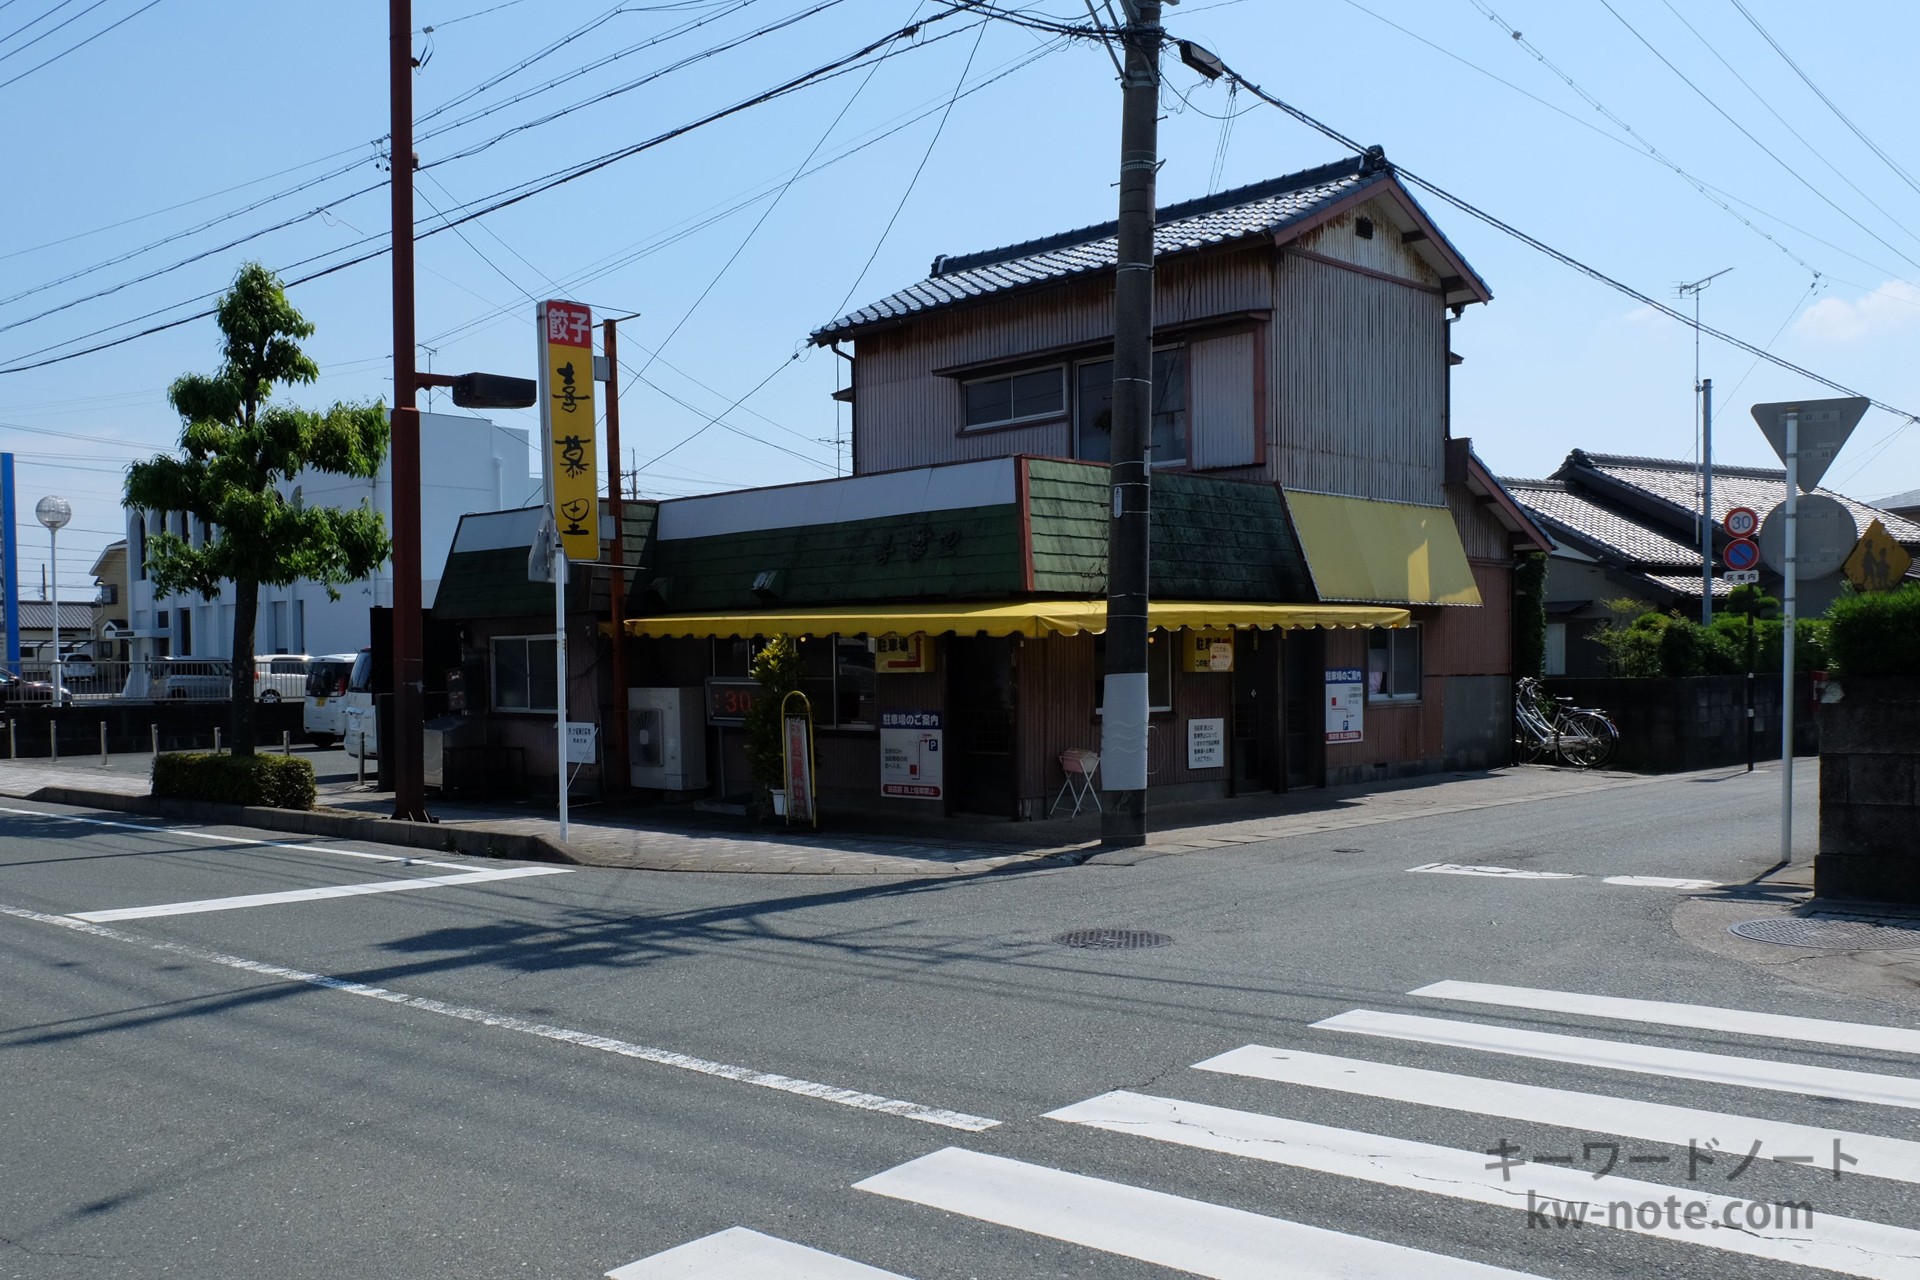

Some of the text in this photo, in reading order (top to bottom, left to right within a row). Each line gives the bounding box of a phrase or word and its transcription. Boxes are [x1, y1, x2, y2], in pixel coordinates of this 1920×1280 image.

[548, 308, 590, 344] 餃子
[1732, 515, 1751, 529] 30
[877, 637, 909, 652] 駐車場
[882, 713, 939, 727] 駐車場のご案内
